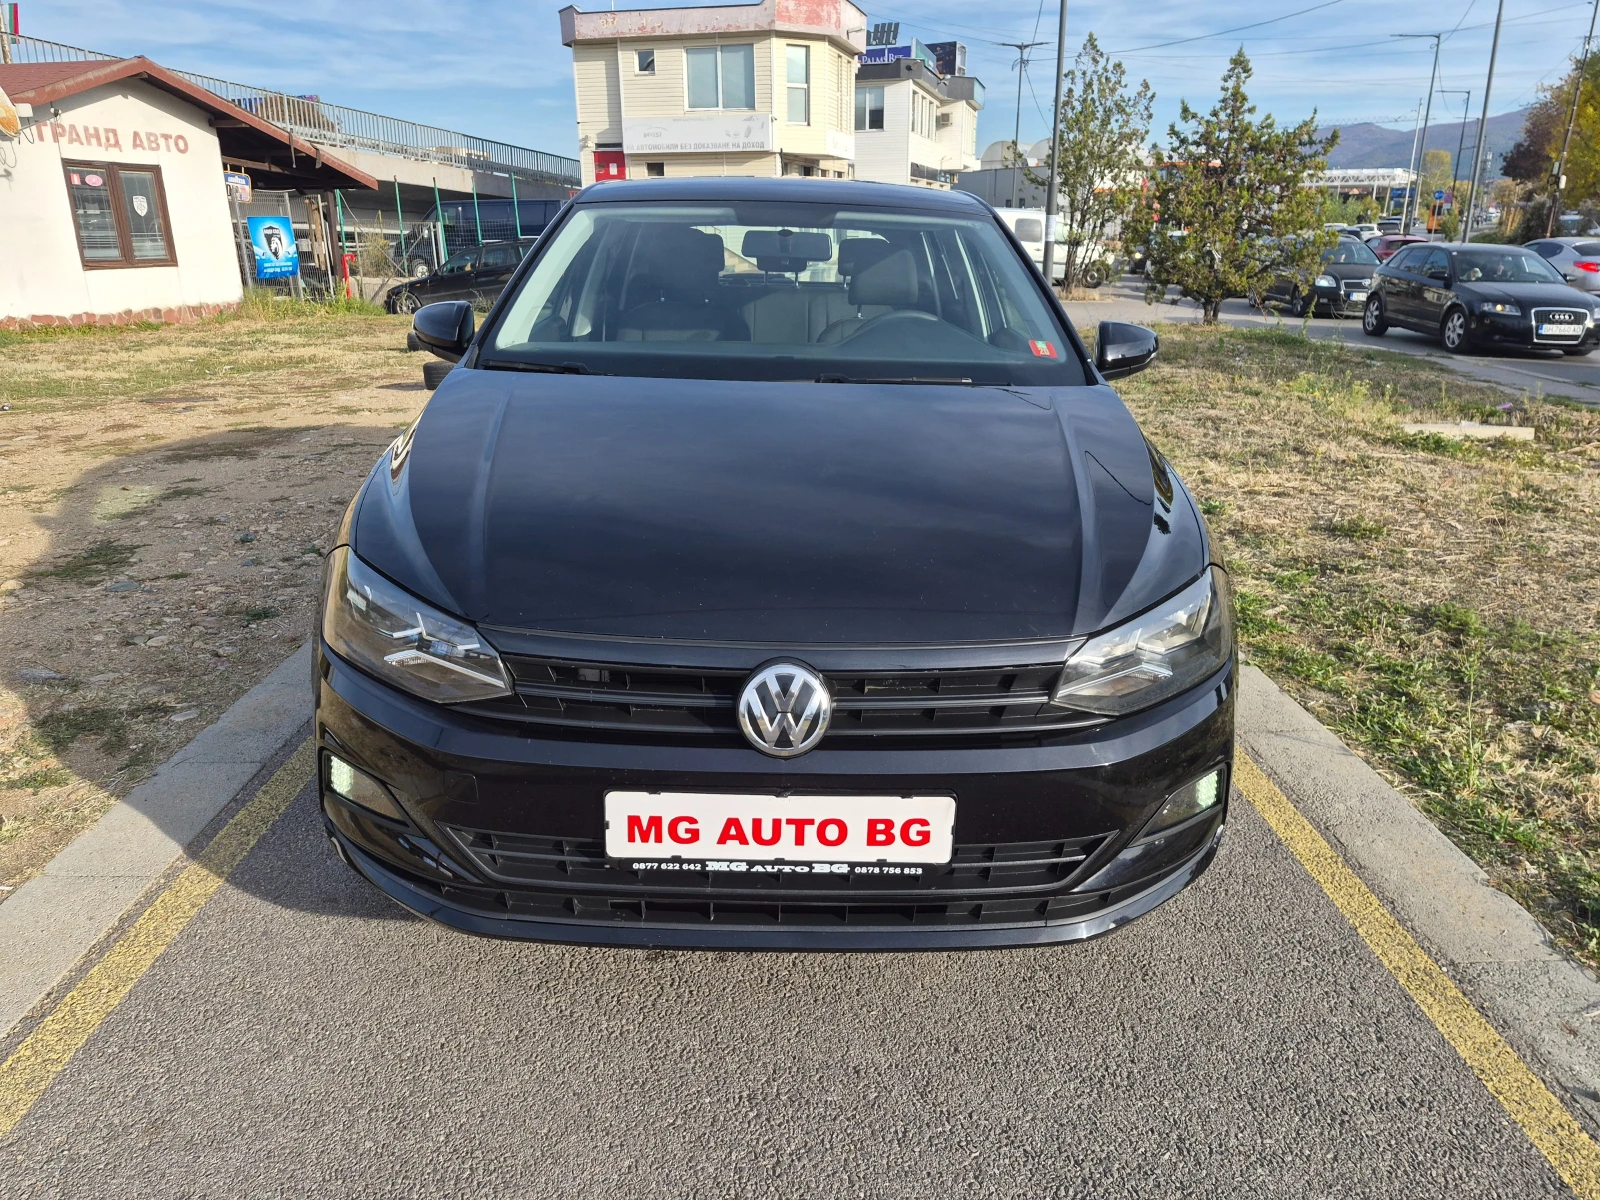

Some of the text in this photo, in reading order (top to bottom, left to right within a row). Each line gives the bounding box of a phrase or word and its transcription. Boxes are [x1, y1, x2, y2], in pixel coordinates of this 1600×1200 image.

[36, 121, 189, 154] ГРАНД АВТО
[636, 143, 679, 151] АВТОМОБИЛИ
[693, 142, 731, 150] ДОКАЗВАНЕ
[742, 141, 765, 149] ДОХОД
[627, 815, 931, 847] MG AUTO BG
[632, 862, 659, 870] 0877
[682, 863, 702, 871] 642
[705, 861, 749, 872] MG
[811, 863, 851, 873] BG
[854, 866, 880, 874] 0878
[882, 866, 902, 875] 756
[903, 867, 923, 875] 853
